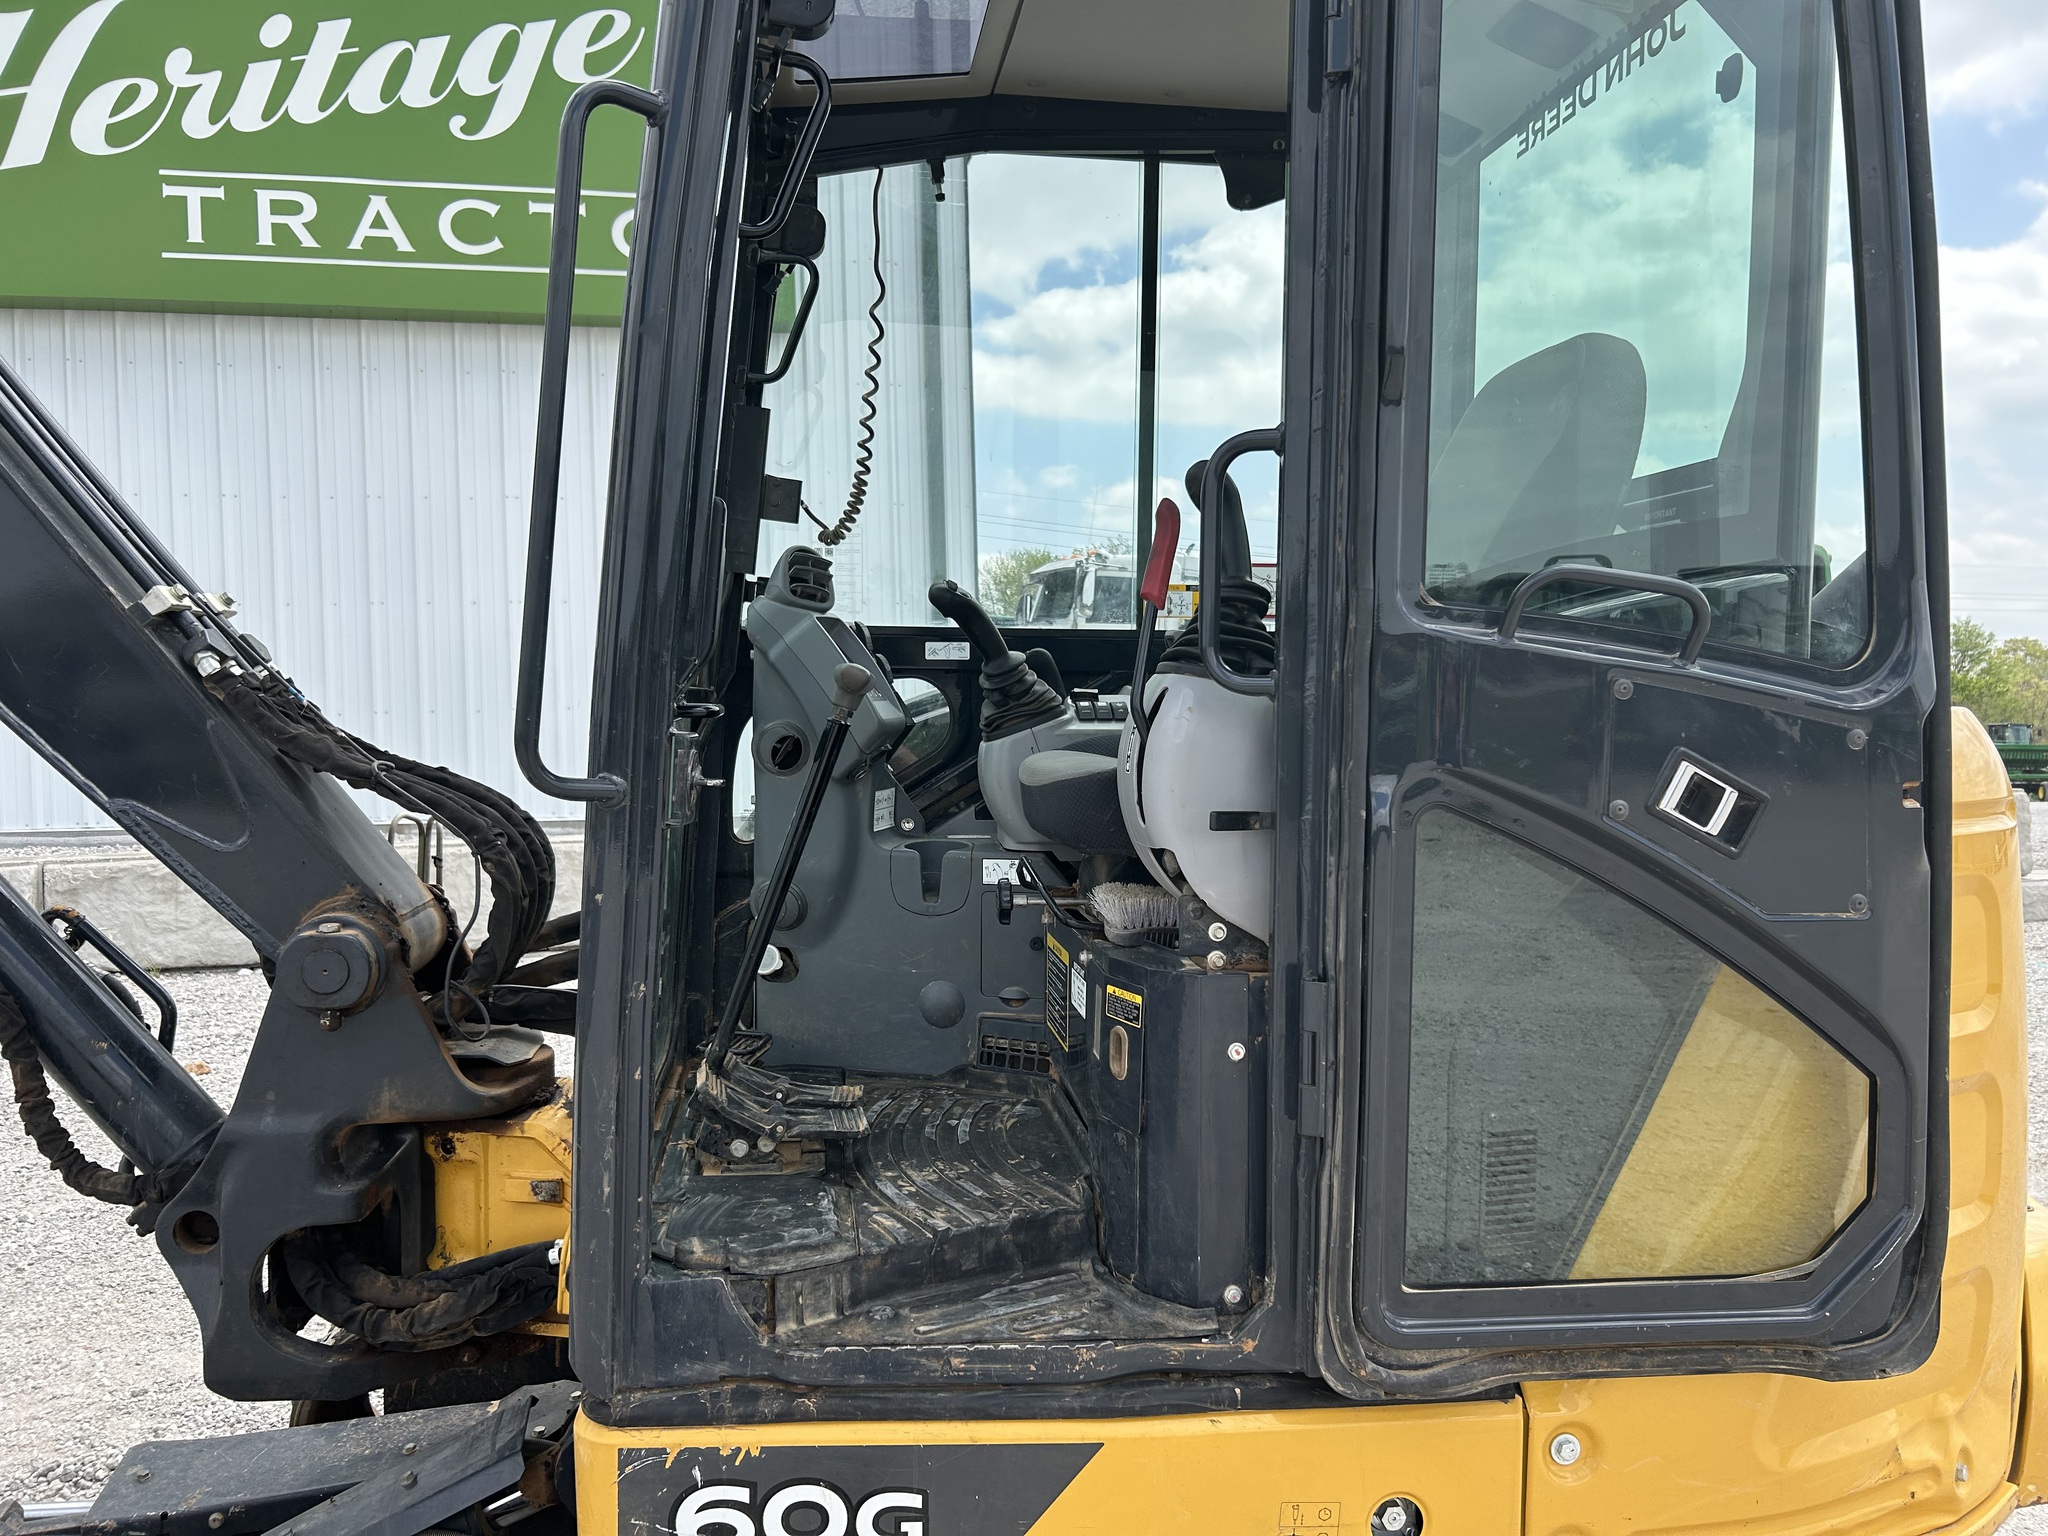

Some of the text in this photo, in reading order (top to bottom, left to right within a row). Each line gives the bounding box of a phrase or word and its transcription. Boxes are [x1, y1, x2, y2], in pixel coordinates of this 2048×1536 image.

[0, 0, 645, 169] Heritage
[162, 183, 634, 257] TRAC
[675, 1484, 923, 1536] 60G
